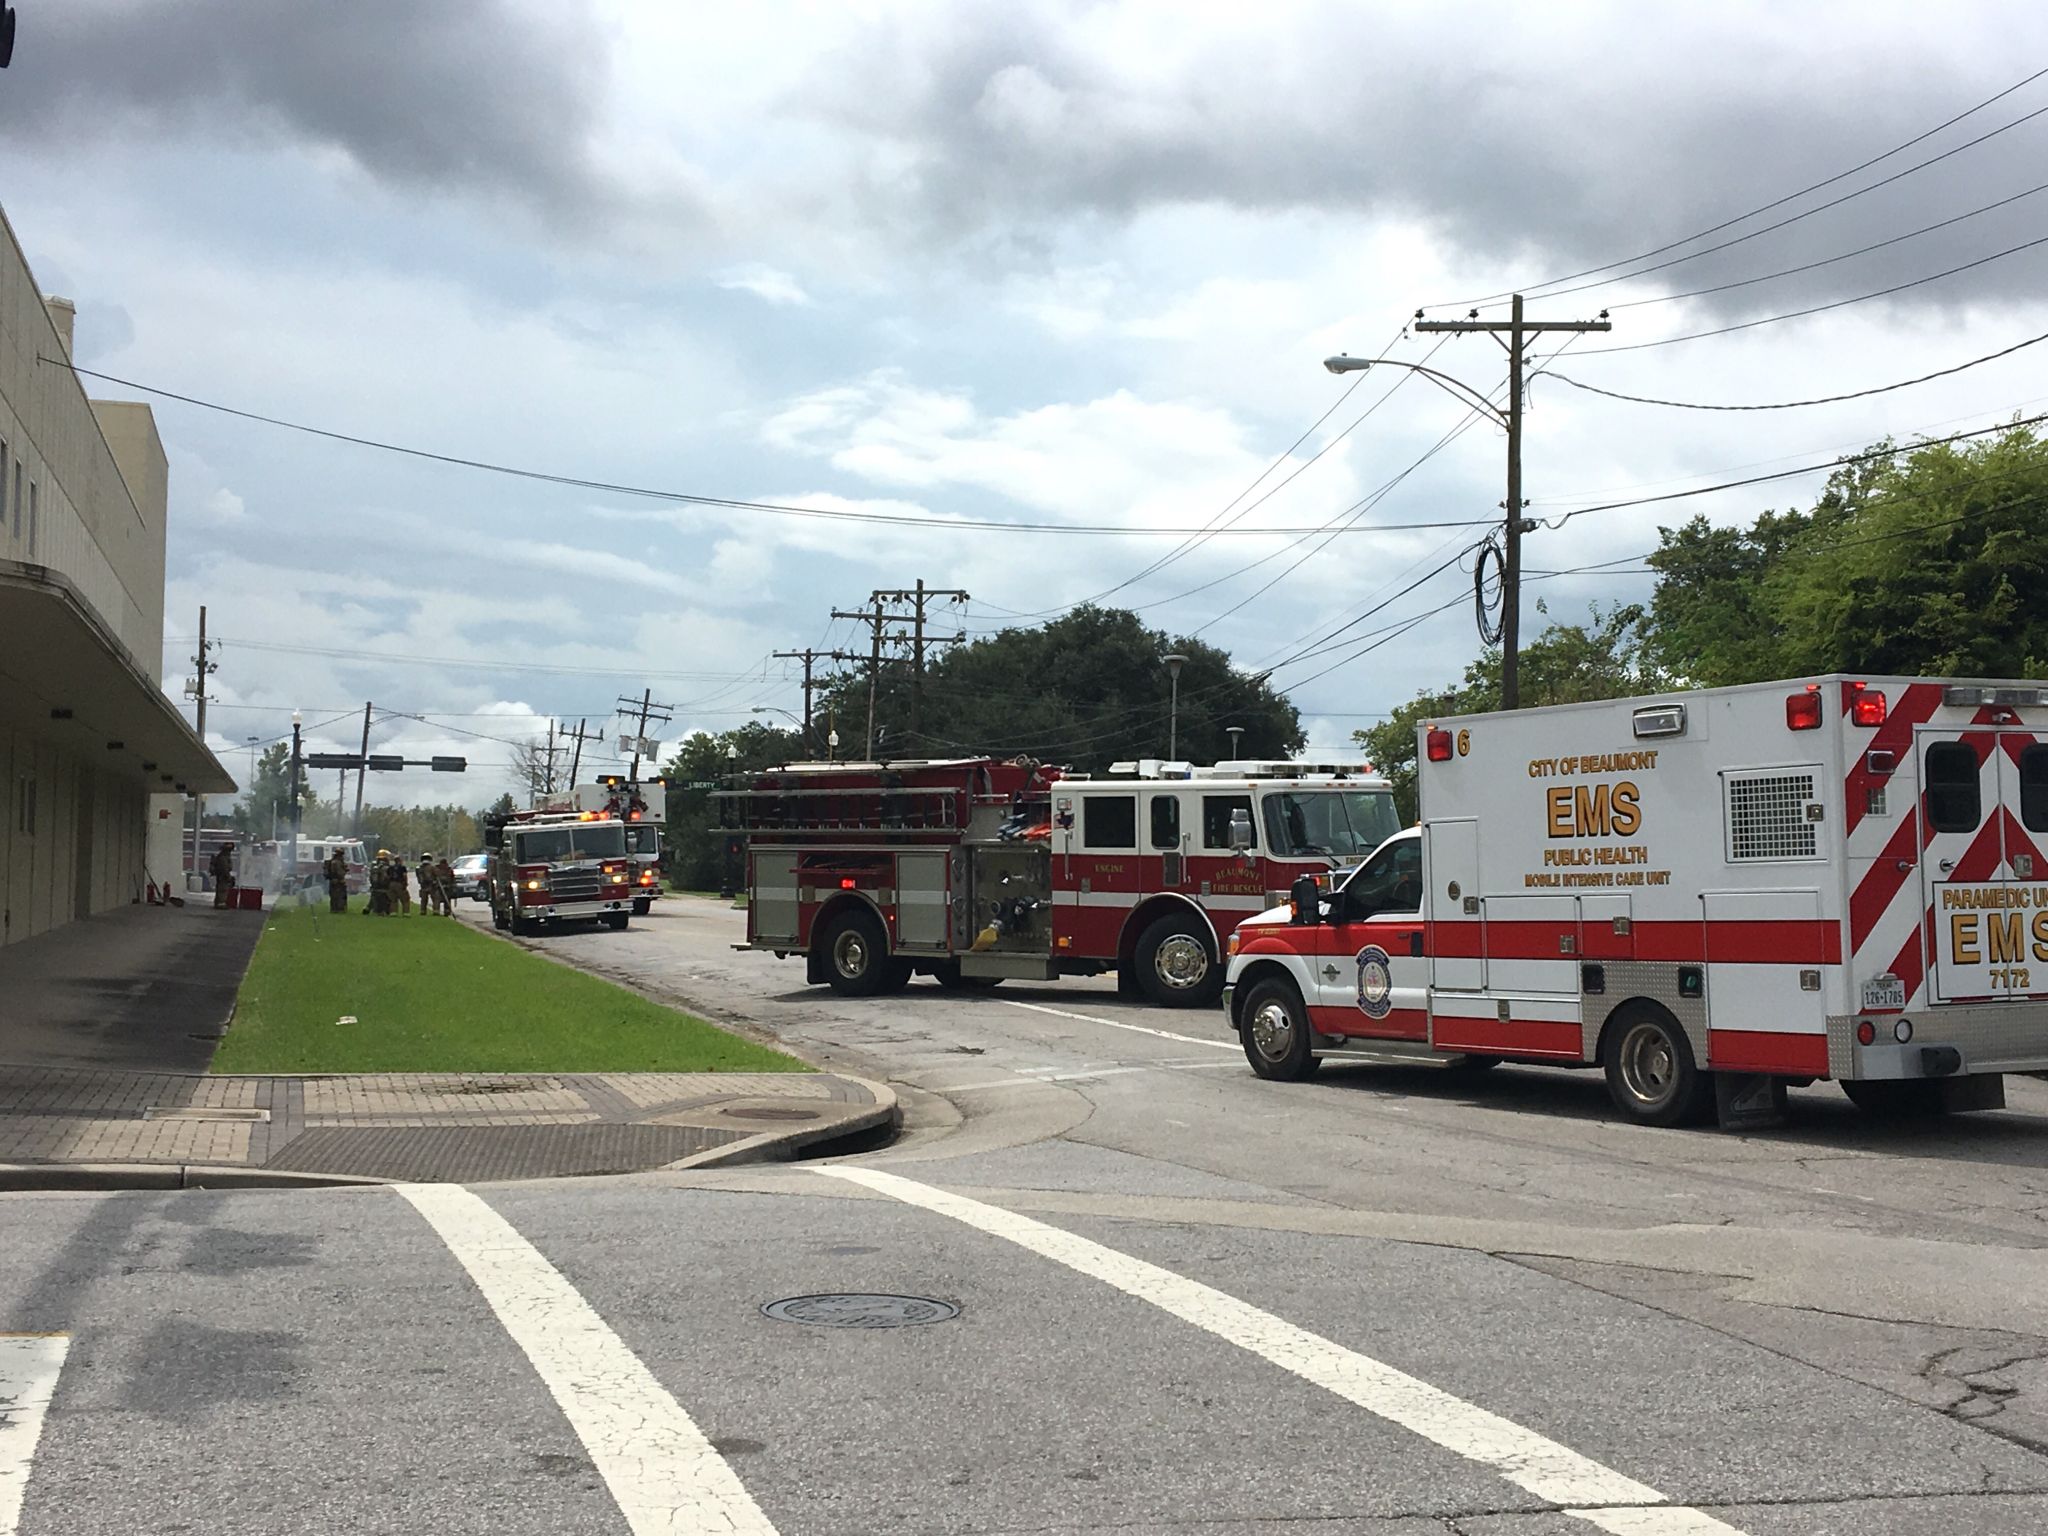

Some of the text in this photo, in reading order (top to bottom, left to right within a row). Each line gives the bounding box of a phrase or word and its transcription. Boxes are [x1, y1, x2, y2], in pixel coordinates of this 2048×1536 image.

[1457, 728, 1470, 757] 6
[1528, 750, 1659, 778] CITY OF BEAUMONT
[688, 781, 715, 789] LIBERTY
[1546, 781, 1642, 838] EMS
[1544, 846, 1648, 866] PUBLIC HEALTH
[1095, 864, 1125, 873] ENGINE
[1215, 866, 1261, 881] BEAUMONT
[1525, 871, 1671, 887] MOBILE INTENSIVE CARE UNIT
[1942, 888, 2030, 910] PARAMEDIC
[1951, 911, 2048, 965] EMS
[1989, 968, 2030, 989] 7172
